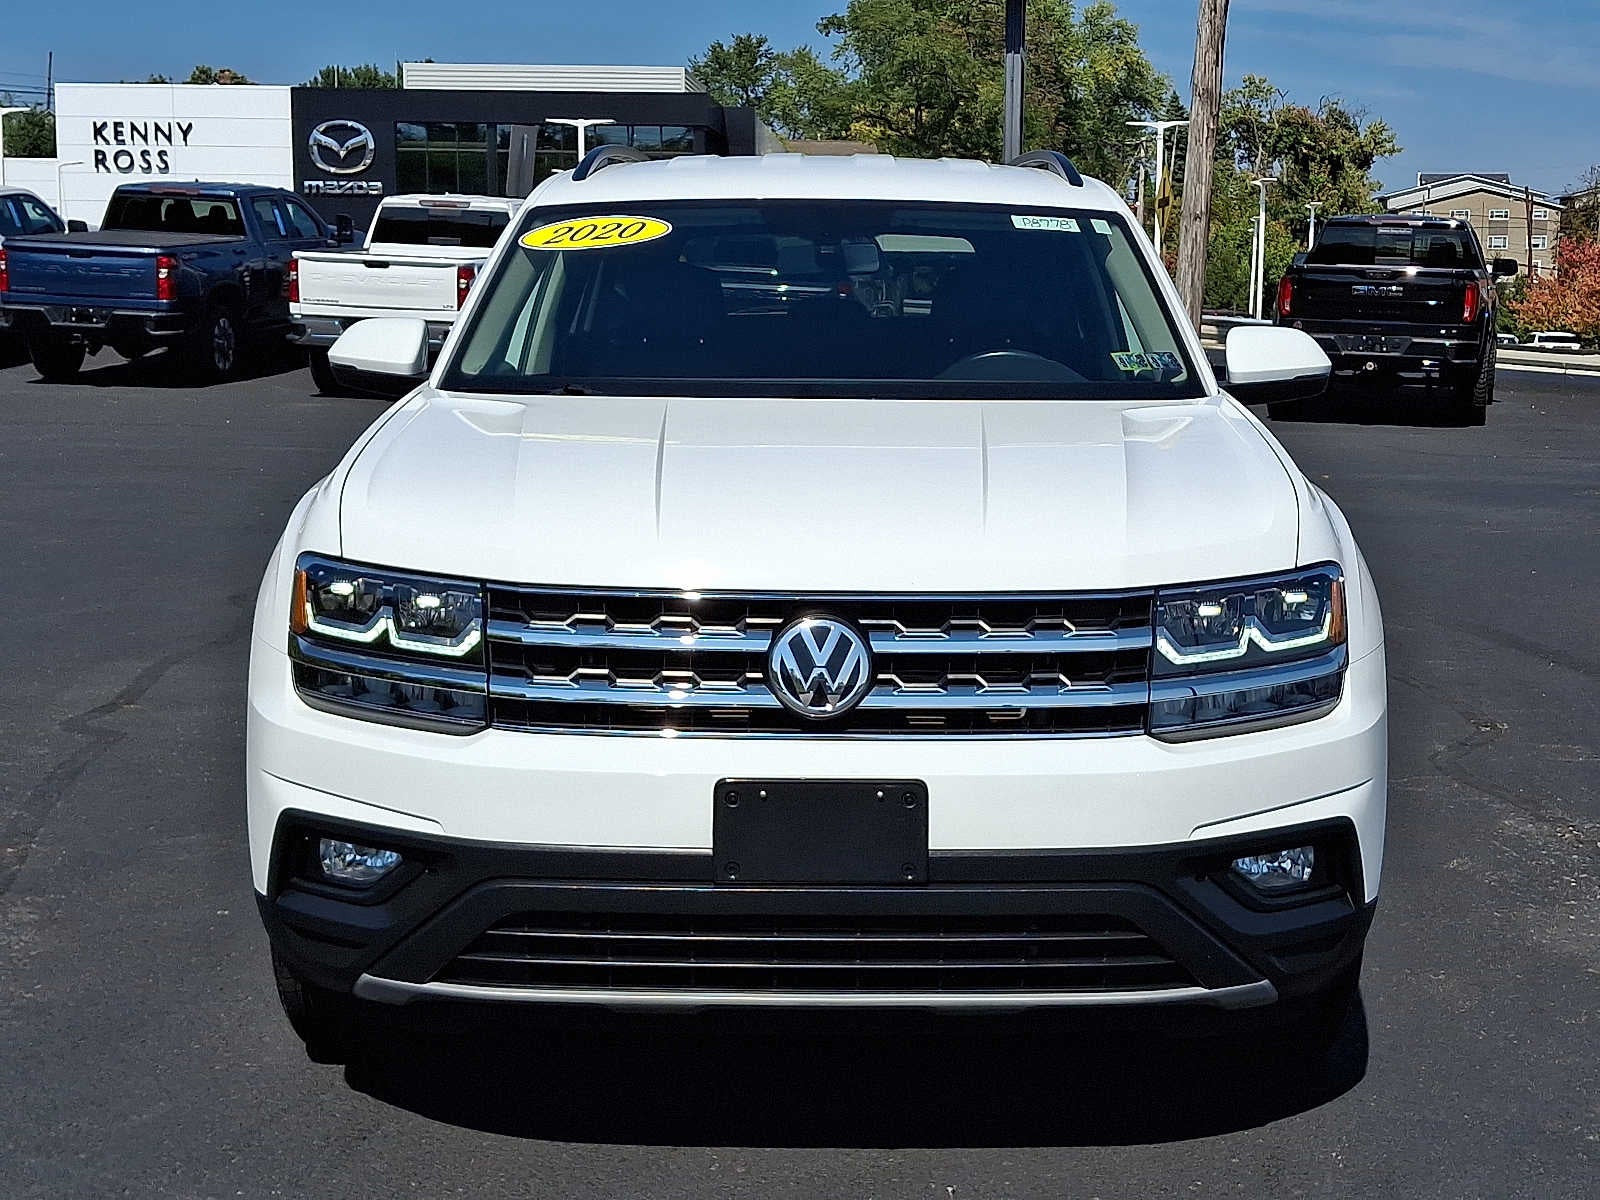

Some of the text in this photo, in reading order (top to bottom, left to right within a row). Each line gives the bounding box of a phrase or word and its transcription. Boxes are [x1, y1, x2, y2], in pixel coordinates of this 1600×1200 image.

[93, 121, 193, 146] KENNY
[94, 149, 169, 174] ROSS
[542, 222, 647, 245] 2020
[773, 618, 867, 711] VW
